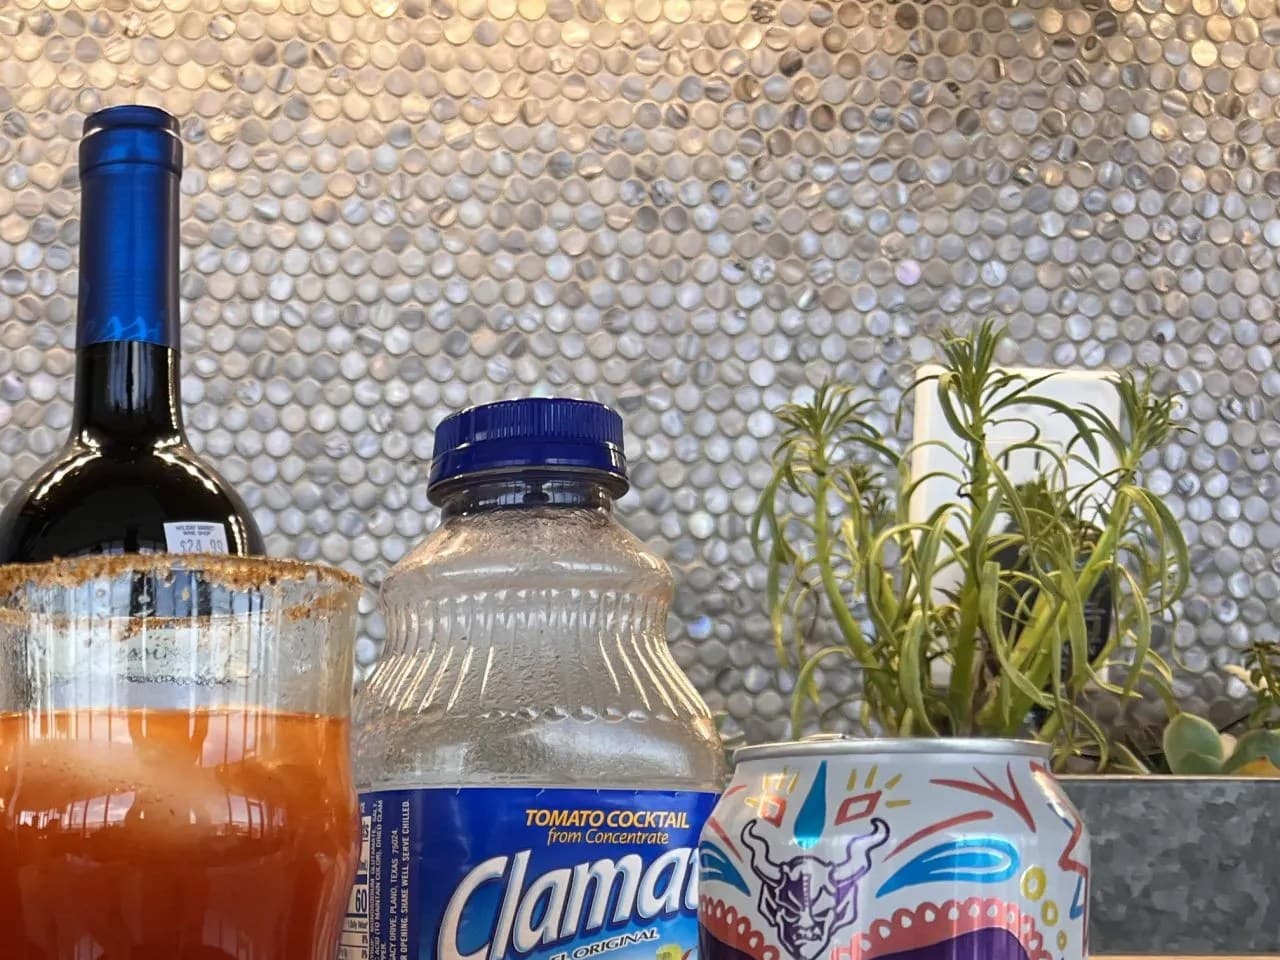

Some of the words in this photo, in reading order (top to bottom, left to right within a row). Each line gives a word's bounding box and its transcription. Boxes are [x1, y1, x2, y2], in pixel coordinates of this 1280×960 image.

[525, 809, 605, 828] TOMATO
[606, 810, 690, 829] COCKTAIL
[402, 836, 410, 862] SERVE
[547, 828, 581, 846] from
[585, 828, 669, 845] Concentrate
[390, 859, 399, 883] TEXAS
[355, 888, 368, 913] 60
[401, 888, 409, 914] SHAKE
[573, 928, 659, 959] ORIGINAL
